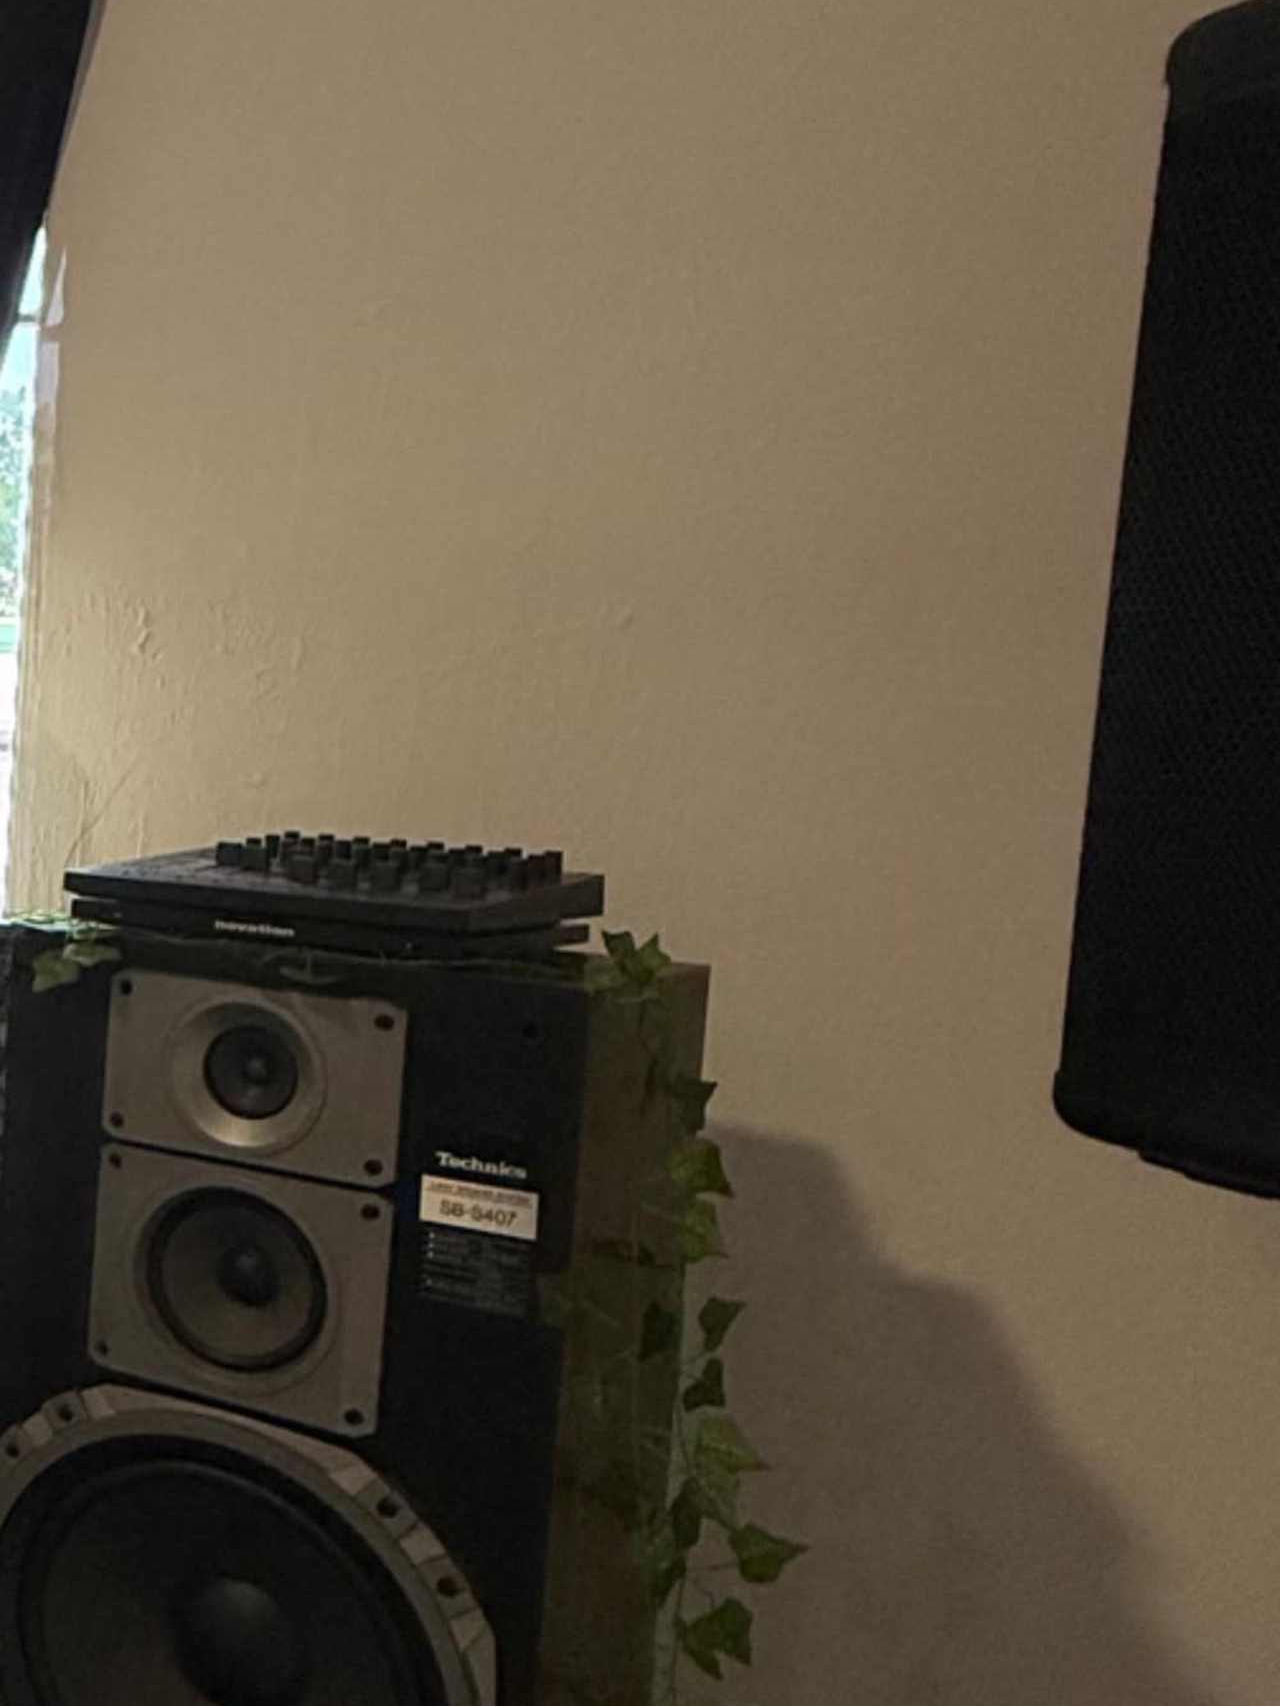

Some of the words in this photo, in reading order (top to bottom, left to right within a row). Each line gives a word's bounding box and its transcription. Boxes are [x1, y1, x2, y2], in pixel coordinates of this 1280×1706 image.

[214, 919, 295, 937] novation
[434, 1151, 527, 1178] Technics
[440, 1199, 517, 1226] SB-S407
